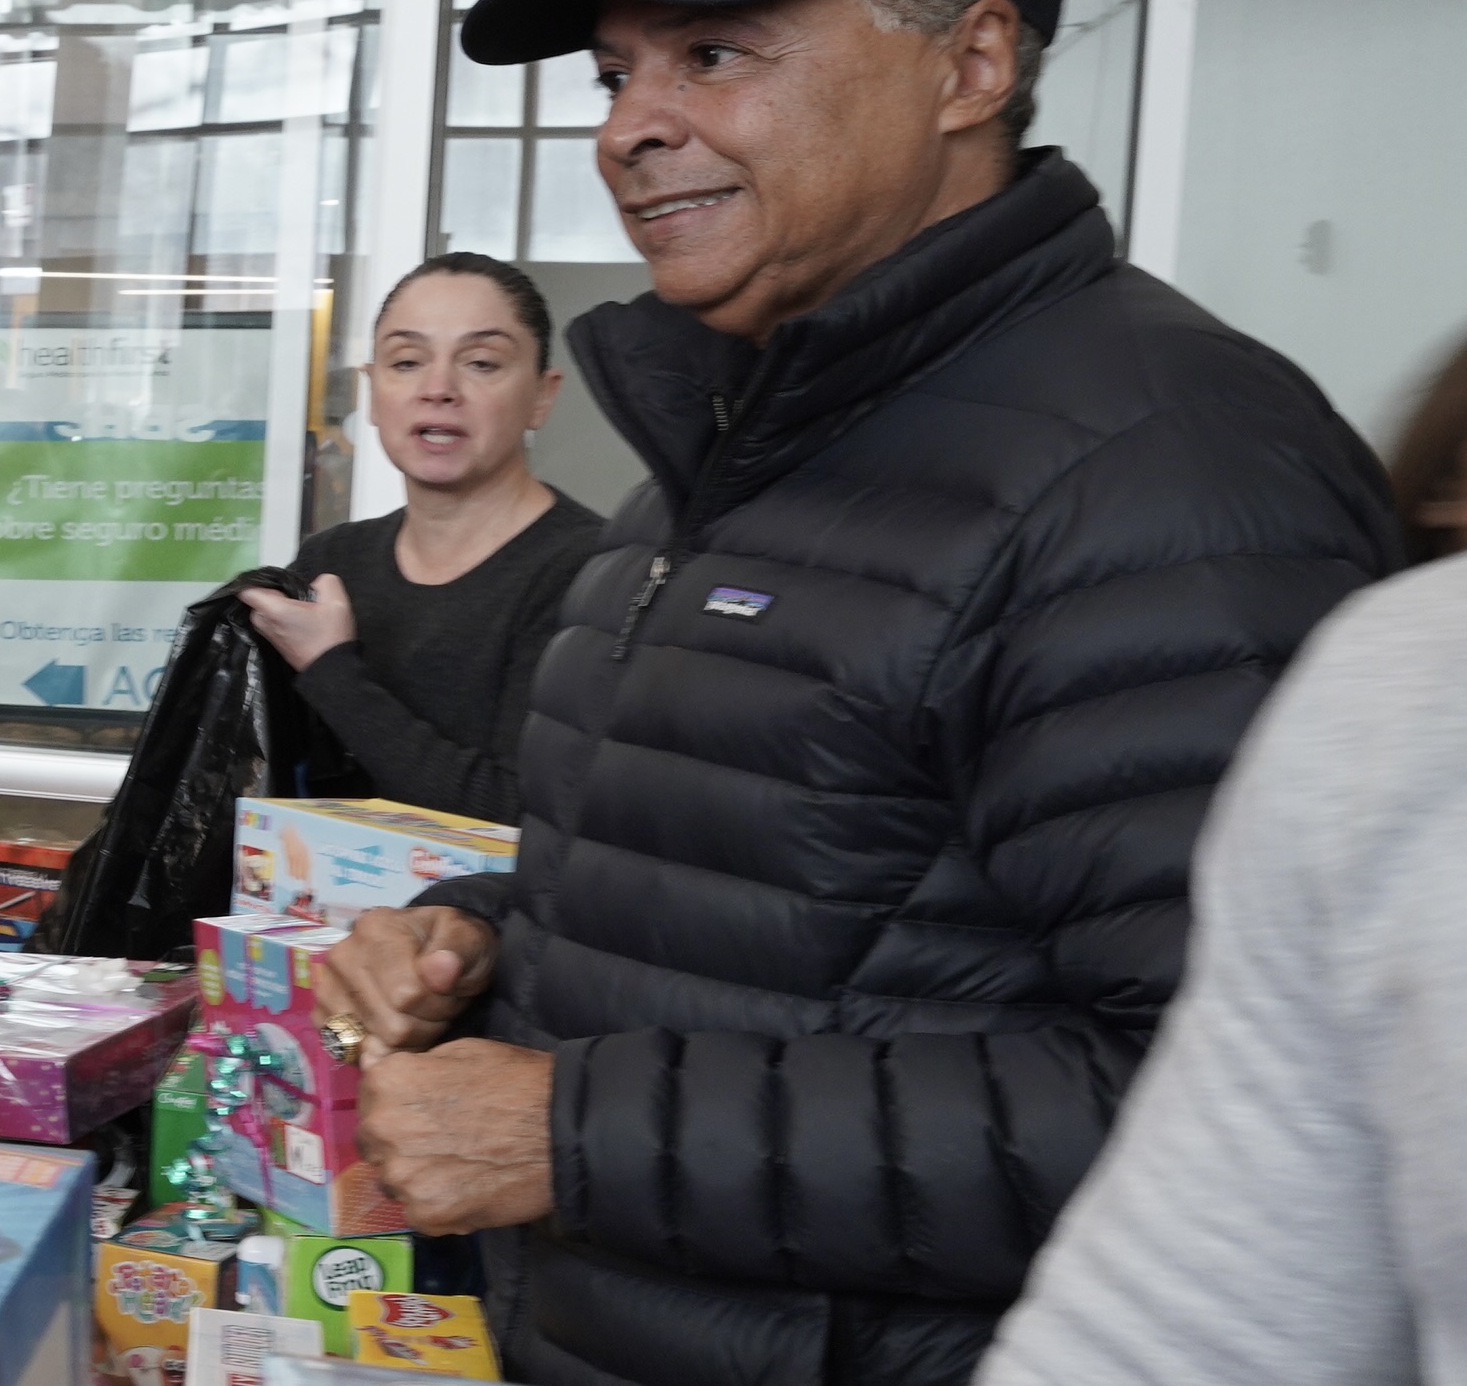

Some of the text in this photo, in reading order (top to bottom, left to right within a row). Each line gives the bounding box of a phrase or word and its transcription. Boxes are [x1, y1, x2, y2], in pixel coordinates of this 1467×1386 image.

[7, 475, 107, 505] ¿Tiene
[61, 520, 169, 546] seguro
[112, 623, 147, 643] las
